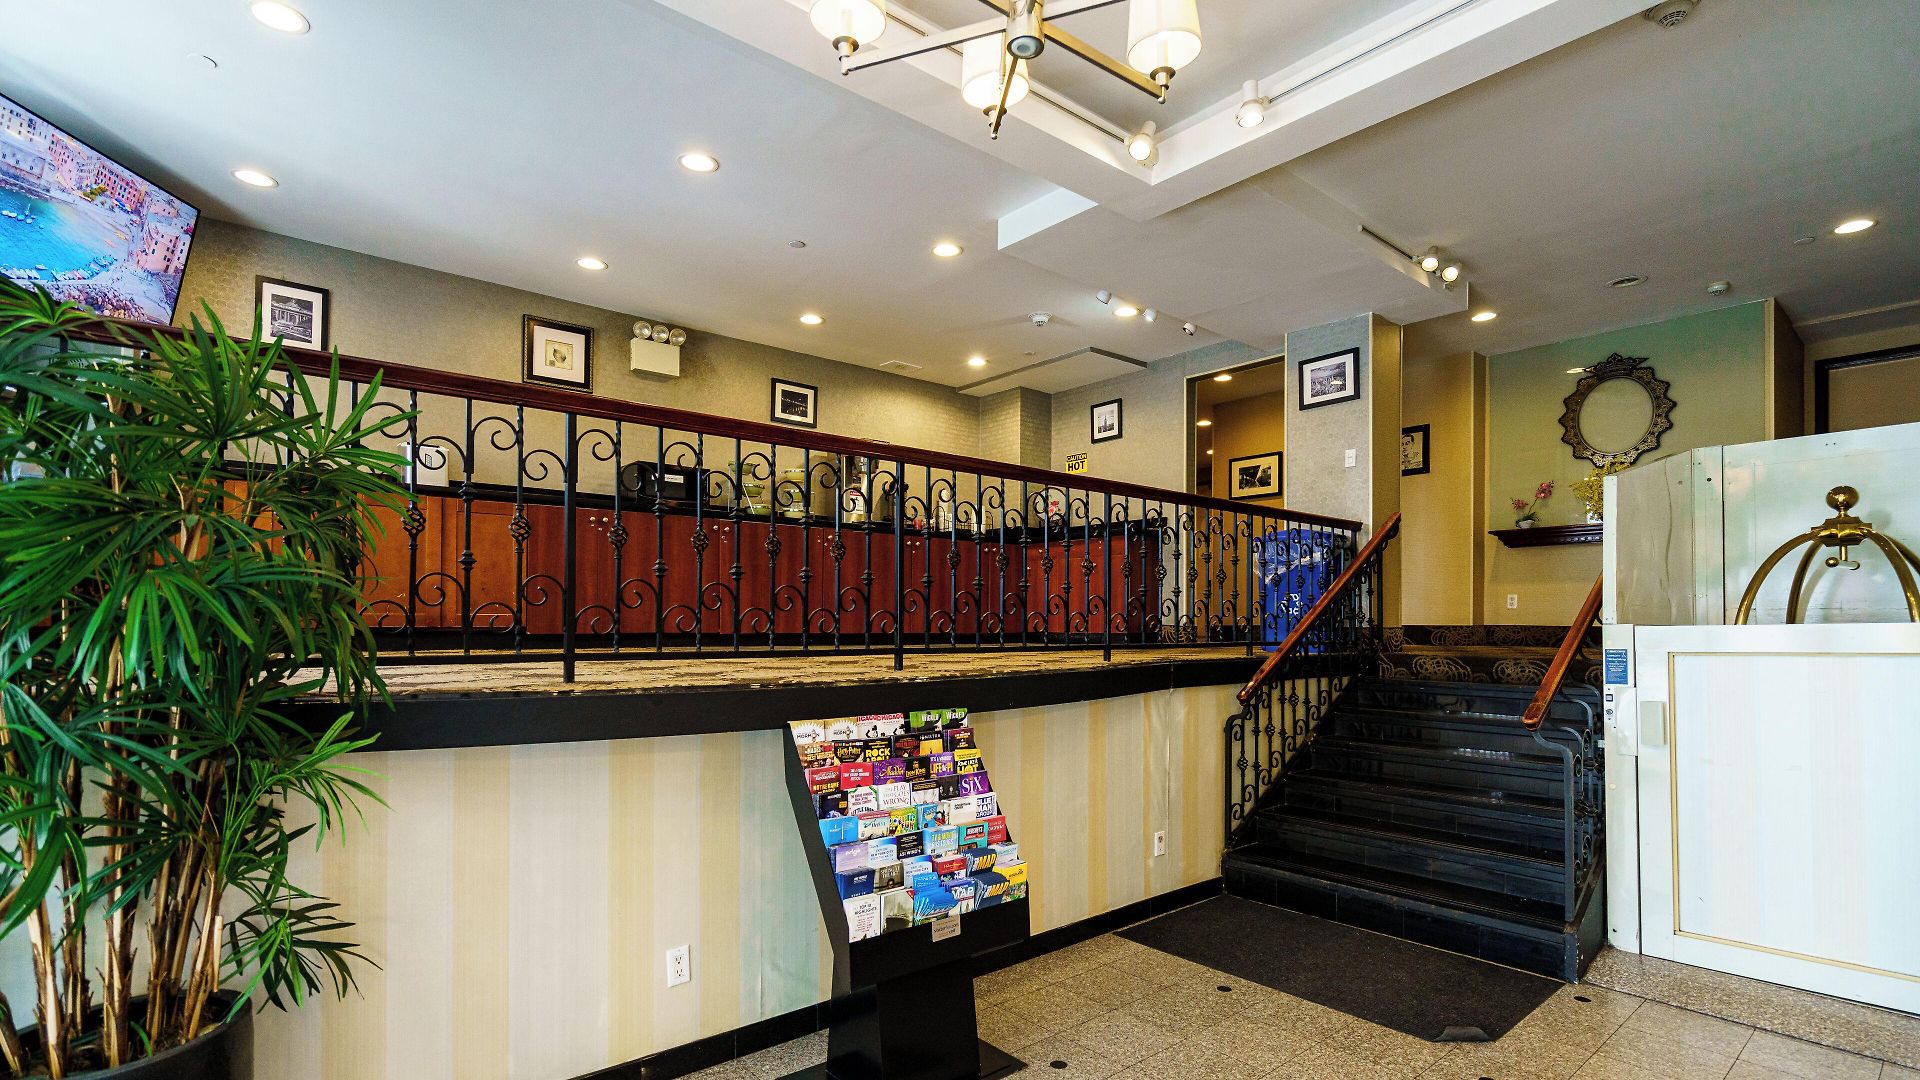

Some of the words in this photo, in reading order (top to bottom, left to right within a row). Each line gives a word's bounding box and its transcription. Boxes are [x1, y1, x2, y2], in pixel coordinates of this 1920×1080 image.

[1067, 460, 1086, 472] HOT
[865, 747, 891, 758] ROCK
[883, 796, 909, 805] WRONG
[976, 853, 997, 871] MAP
[987, 881, 1009, 897] MAP
